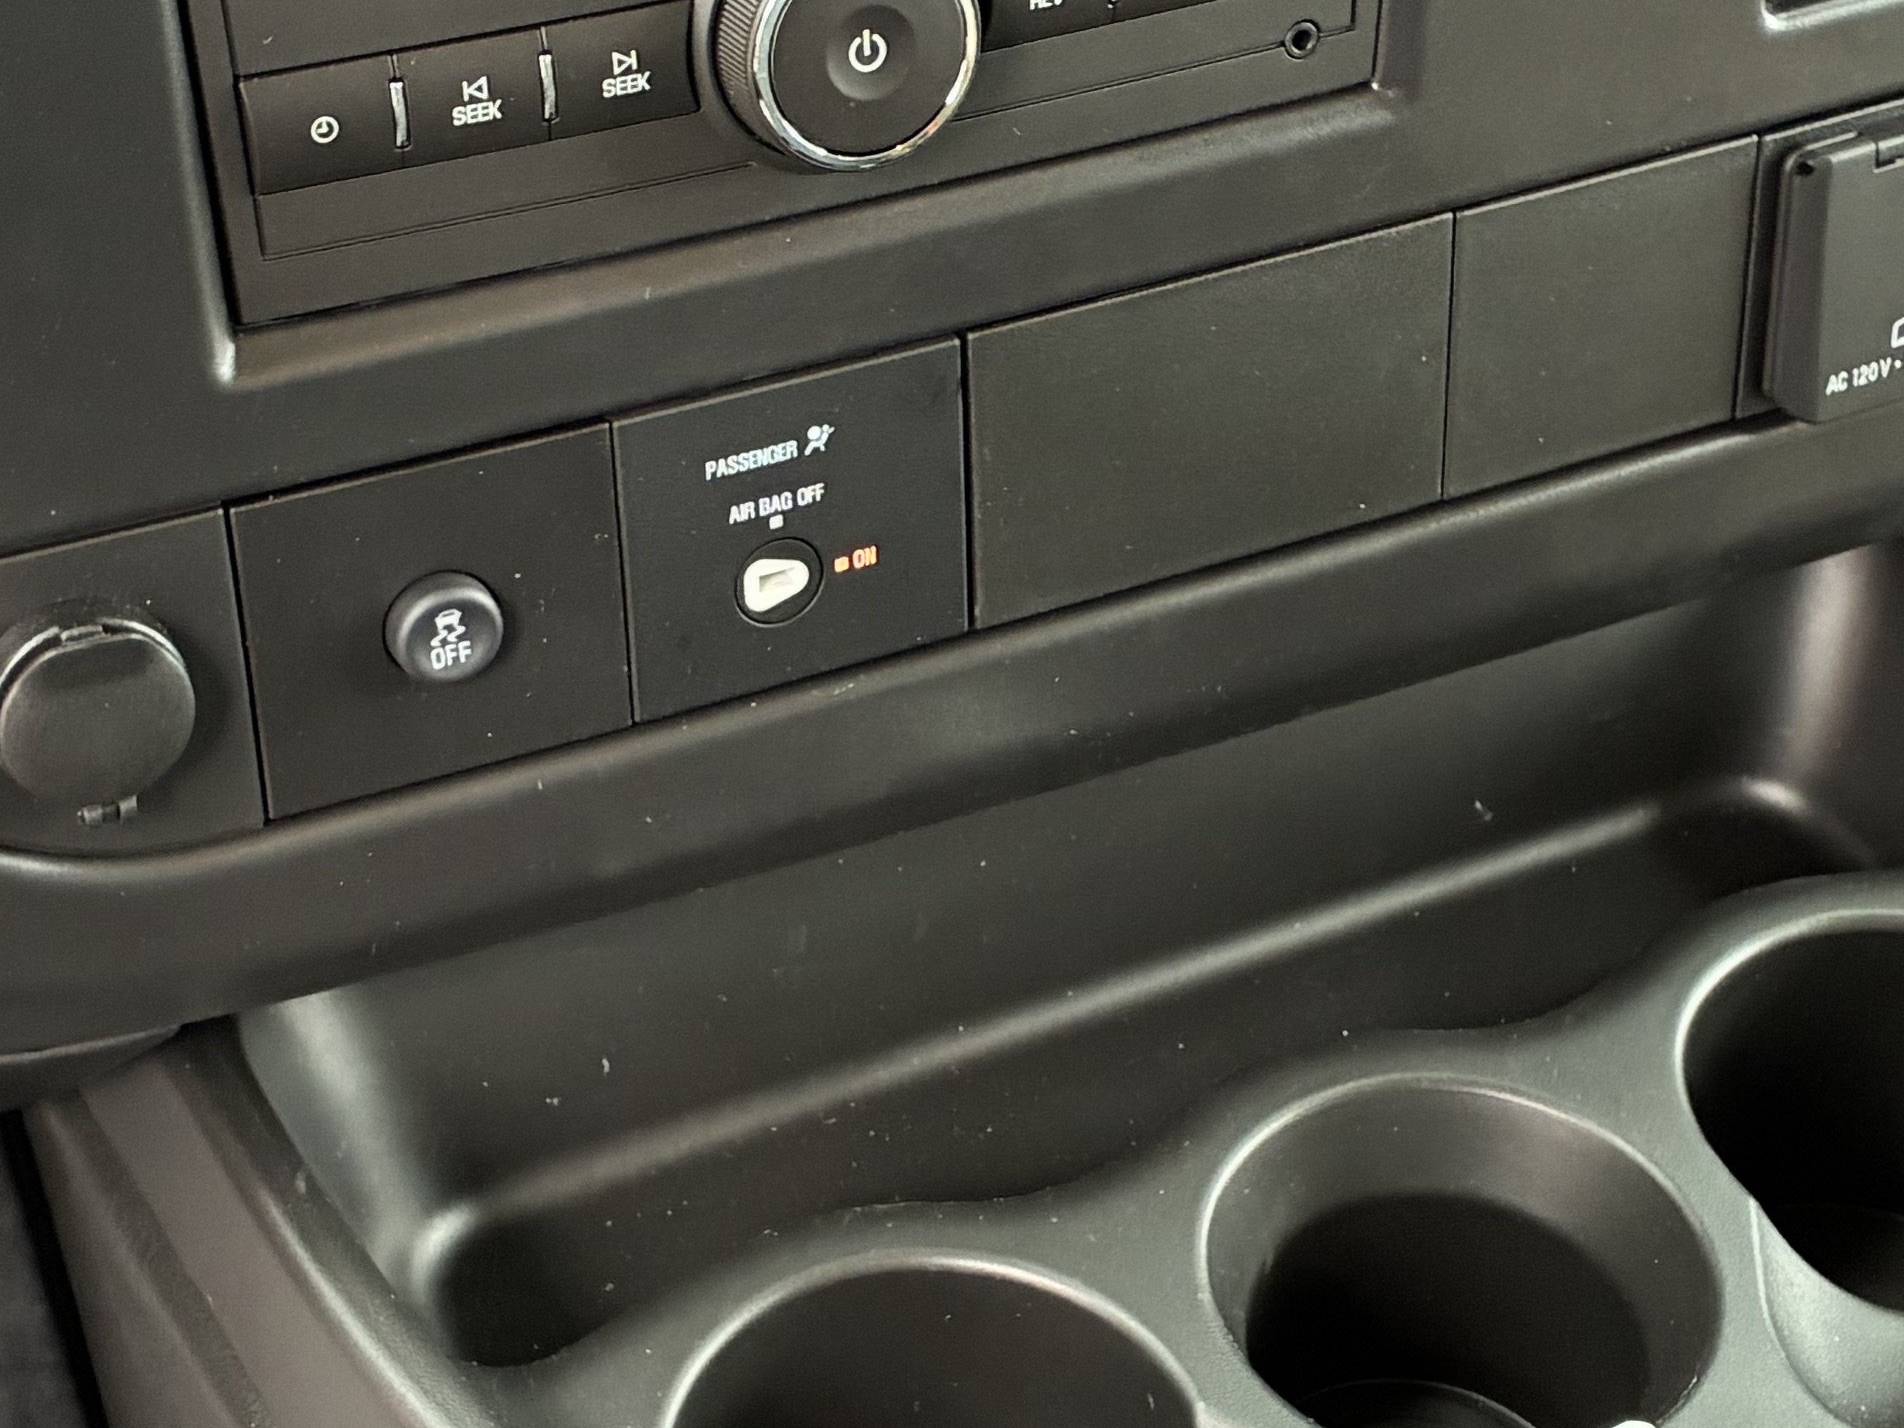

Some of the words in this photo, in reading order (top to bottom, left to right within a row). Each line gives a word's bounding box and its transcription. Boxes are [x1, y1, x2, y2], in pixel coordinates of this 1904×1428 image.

[601, 70, 652, 99] SEEK
[451, 99, 504, 127] SEEK
[1825, 370, 1849, 396] AC
[704, 439, 799, 482] PASSENGER
[728, 500, 757, 525] AIR
[758, 490, 793, 518] BAG
[796, 482, 826, 507] OFF
[852, 544, 878, 569] ON
[429, 640, 473, 671] OFF
